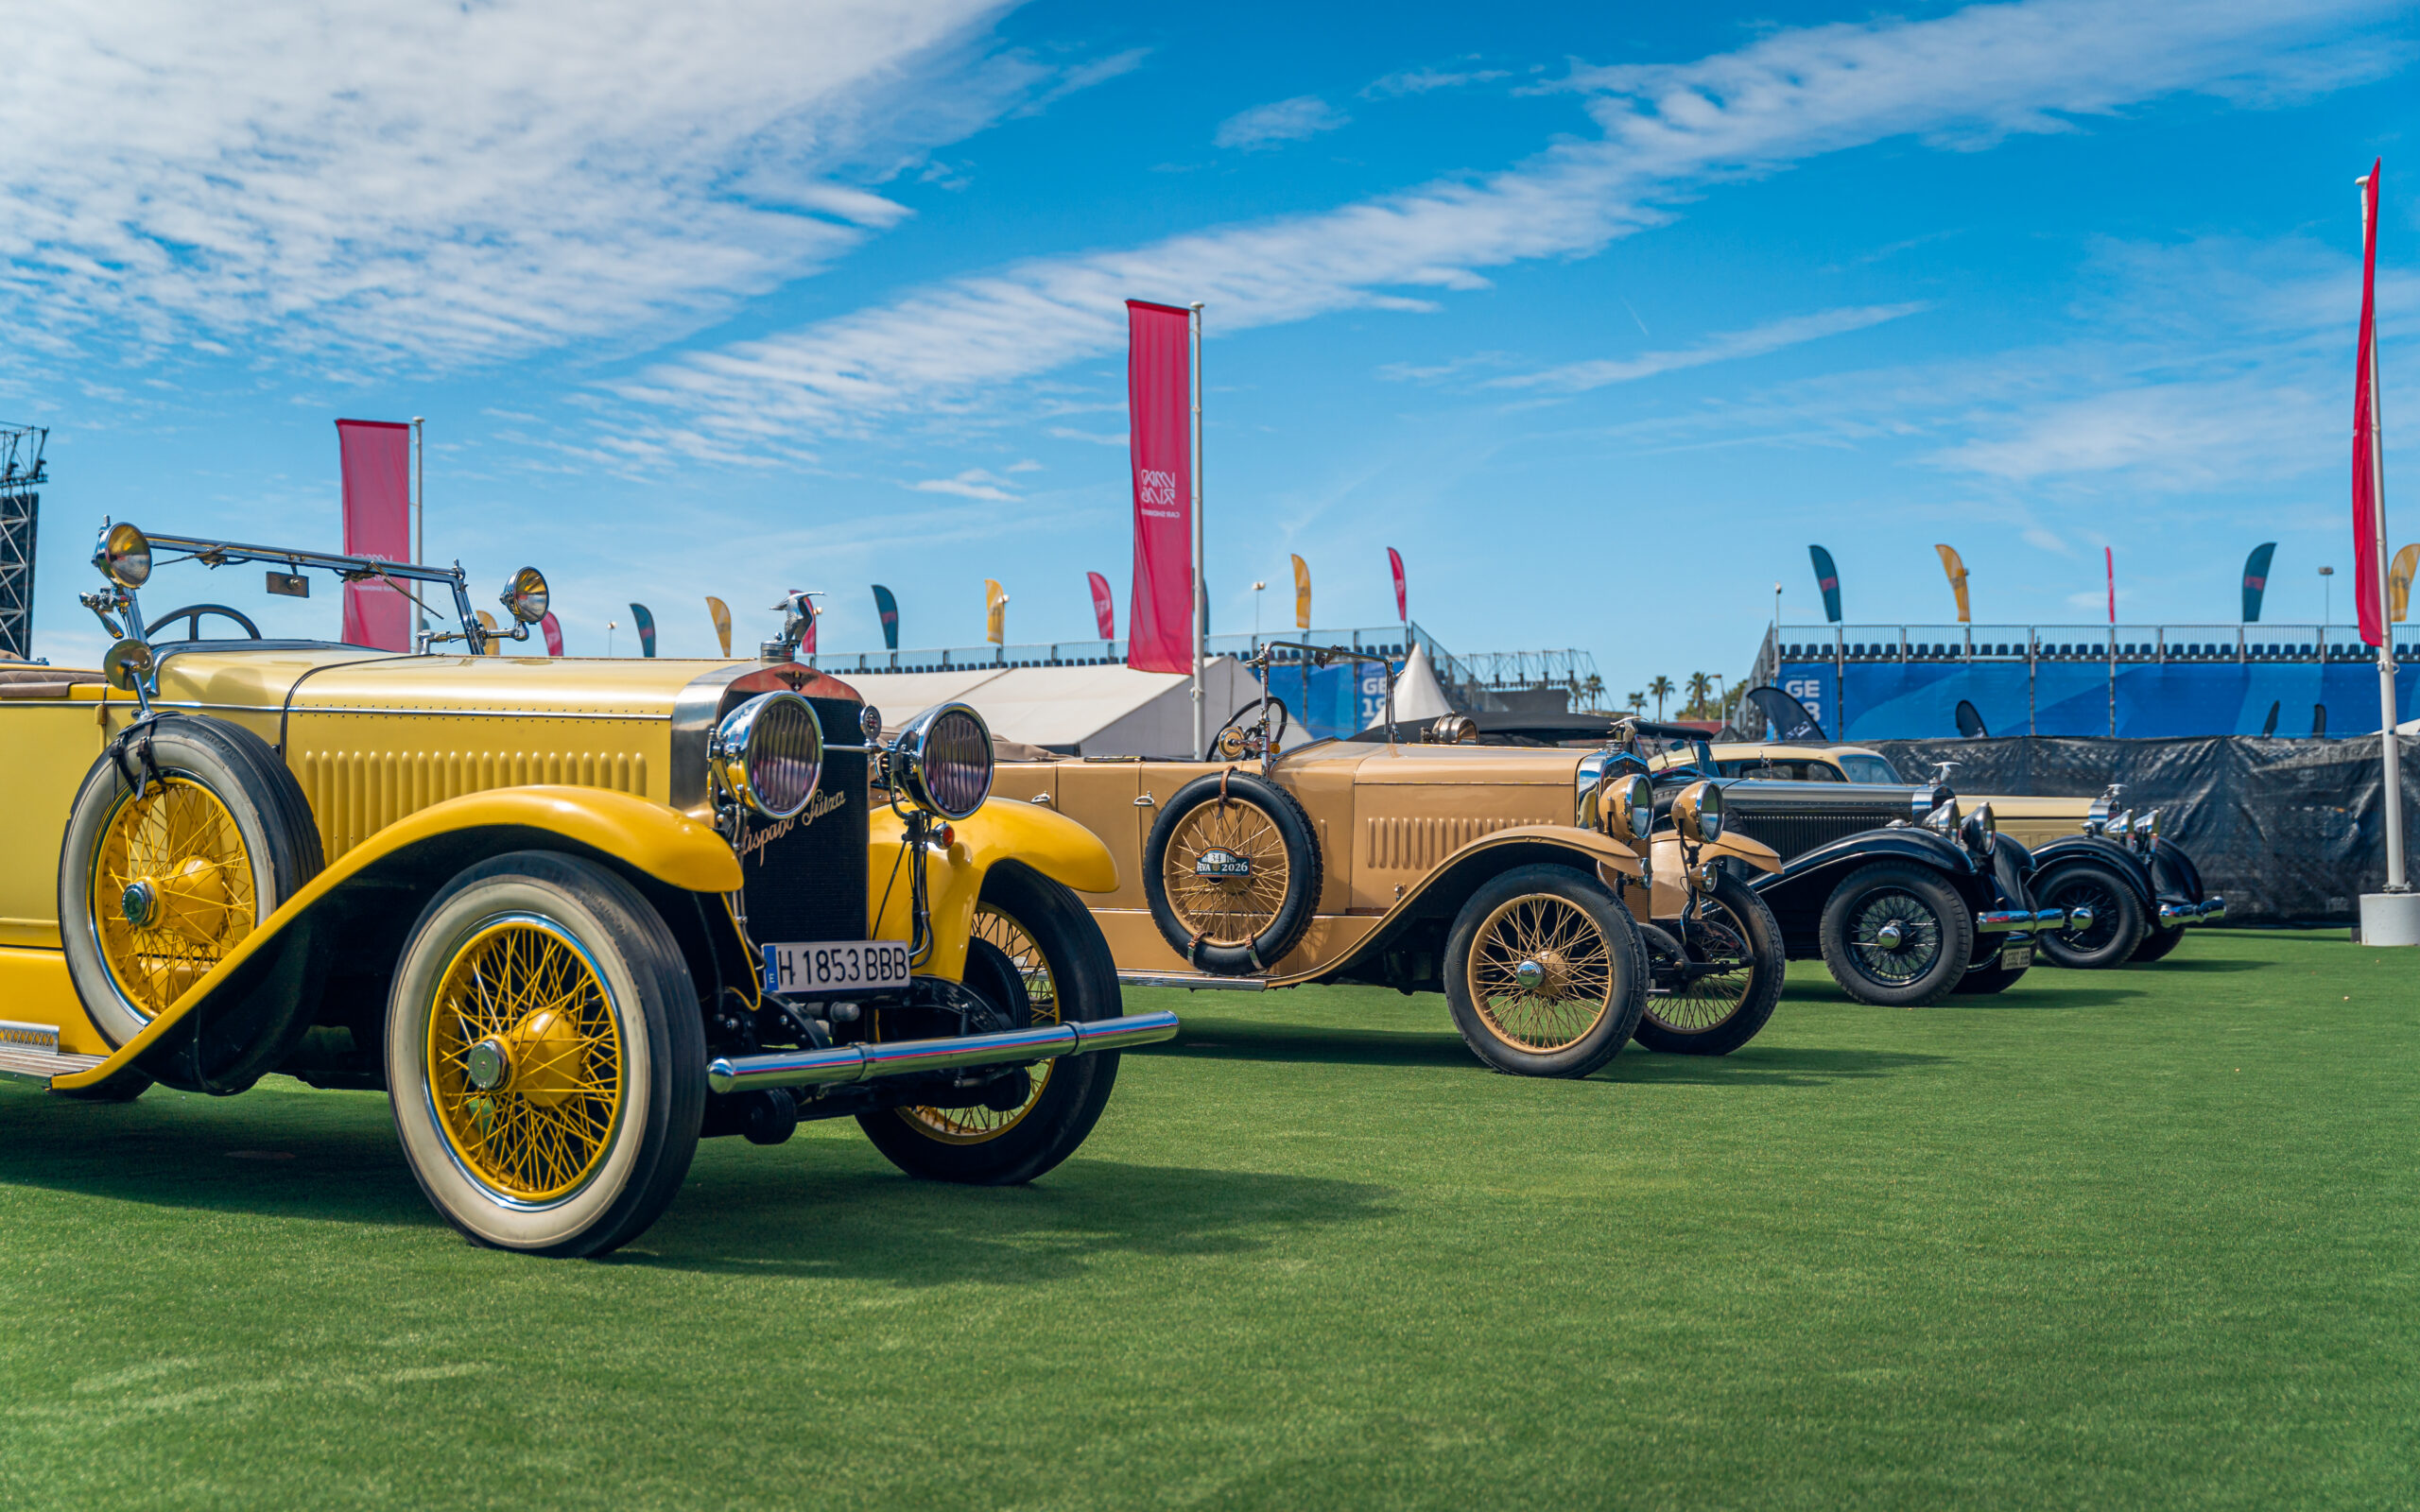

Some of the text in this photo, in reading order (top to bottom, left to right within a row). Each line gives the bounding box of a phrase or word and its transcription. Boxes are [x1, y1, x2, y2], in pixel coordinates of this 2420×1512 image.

[1785, 679, 1821, 698] GE
[802, 788, 847, 826] Suiza
[1197, 861, 1248, 871] FEVA 2026
[1210, 853, 1221, 862] 34
[778, 947, 907, 985] H 1853 BBB
